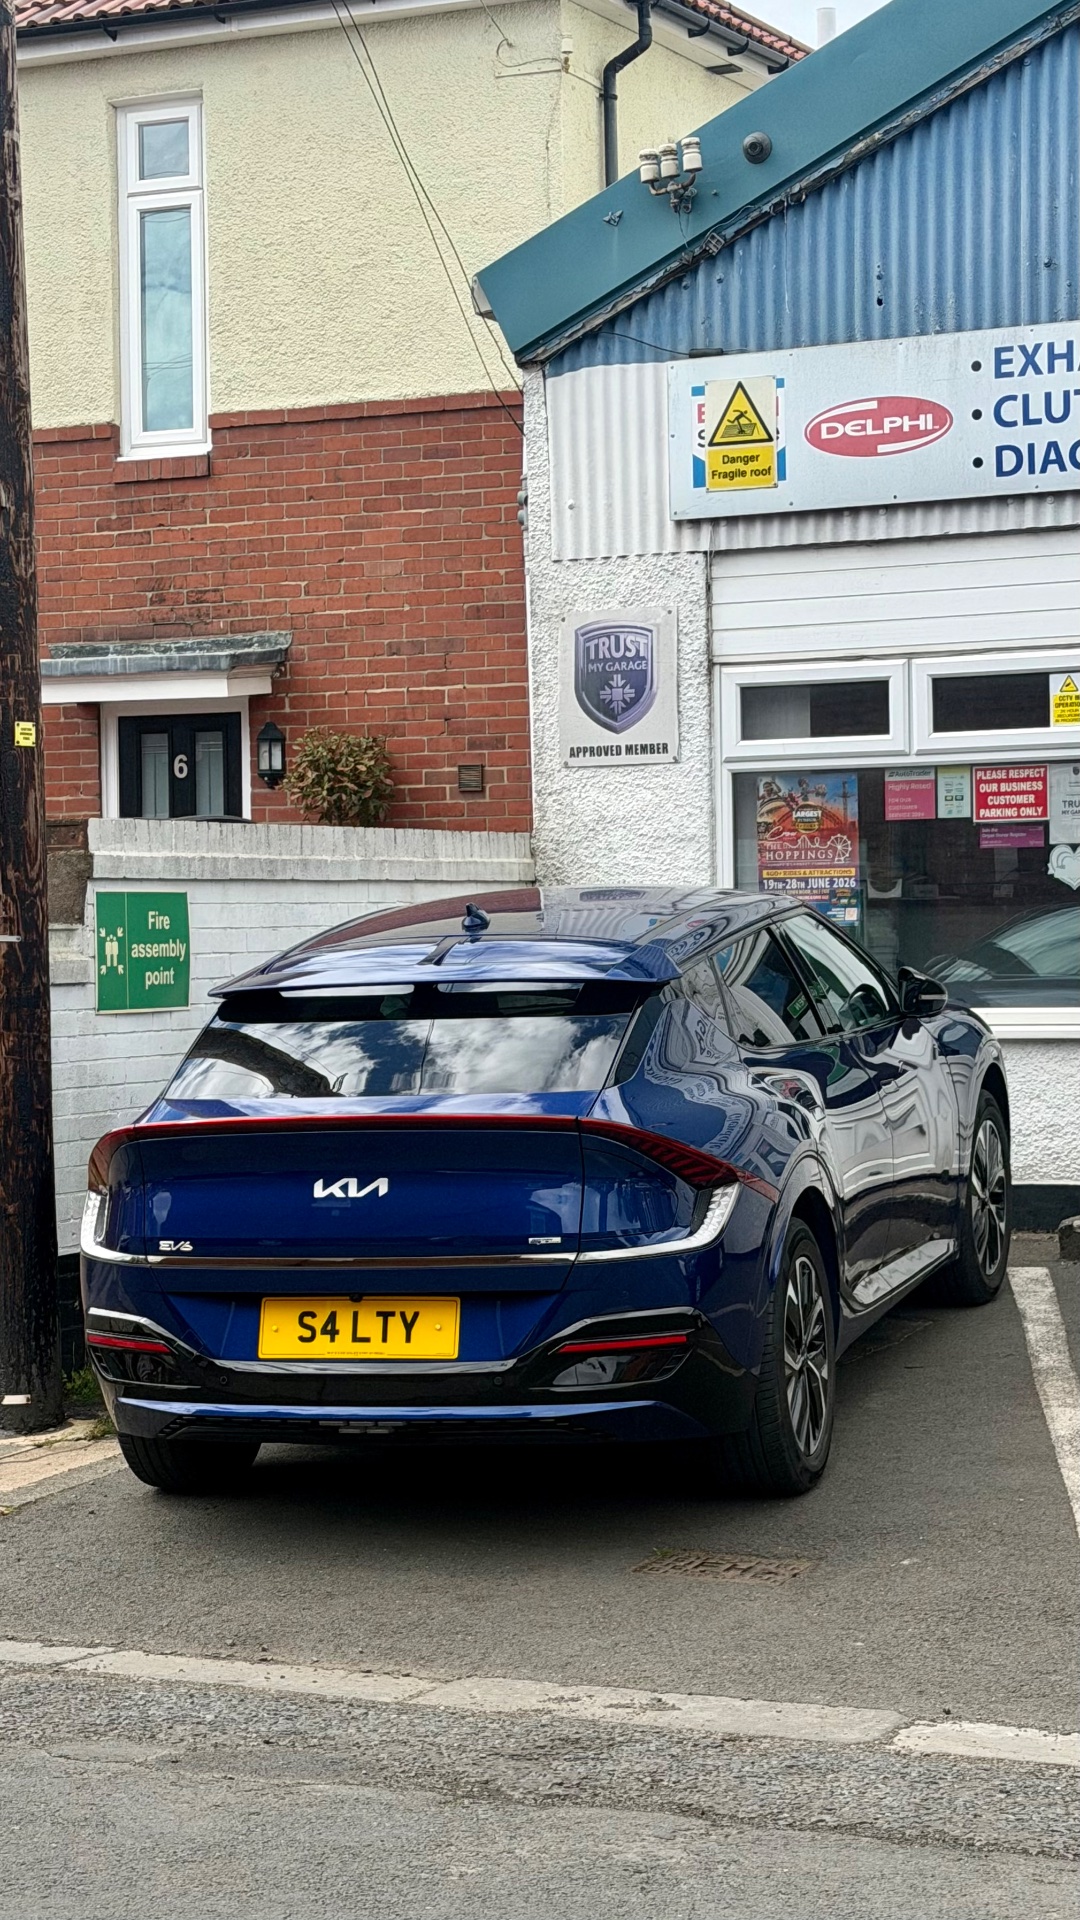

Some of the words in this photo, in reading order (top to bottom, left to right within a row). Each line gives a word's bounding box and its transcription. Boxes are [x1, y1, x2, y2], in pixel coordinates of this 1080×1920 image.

[994, 341, 1080, 379] EXH
[993, 389, 1080, 428] CLU
[821, 413, 933, 439] DELPHI
[722, 454, 760, 466] Danger
[711, 468, 747, 481] Fragile
[750, 466, 772, 477] roof
[585, 634, 648, 660] TRUST
[588, 662, 604, 673] MY
[606, 660, 648, 672] GARAGE
[569, 744, 622, 758] APPROVED
[625, 742, 669, 756] MEMBER
[173, 755, 188, 779] 6
[976, 770, 1007, 780] PLEASE
[1009, 768, 1045, 779] RESPECT
[979, 783, 998, 793] OUR
[1000, 781, 1043, 792] BUSINESS
[987, 794, 1035, 805] CUSTOMER
[979, 807, 1018, 818] PARKING
[1020, 806, 1043, 816] ONLY
[765, 850, 833, 861] HOPPINGS
[807, 877, 830, 889] JUNE
[833, 877, 856, 889] 2026
[148, 911, 170, 930] Fire
[131, 939, 186, 961] assembly
[145, 966, 175, 990] point
[314, 1177, 389, 1198] KIA
[159, 1240, 194, 1251] EV6
